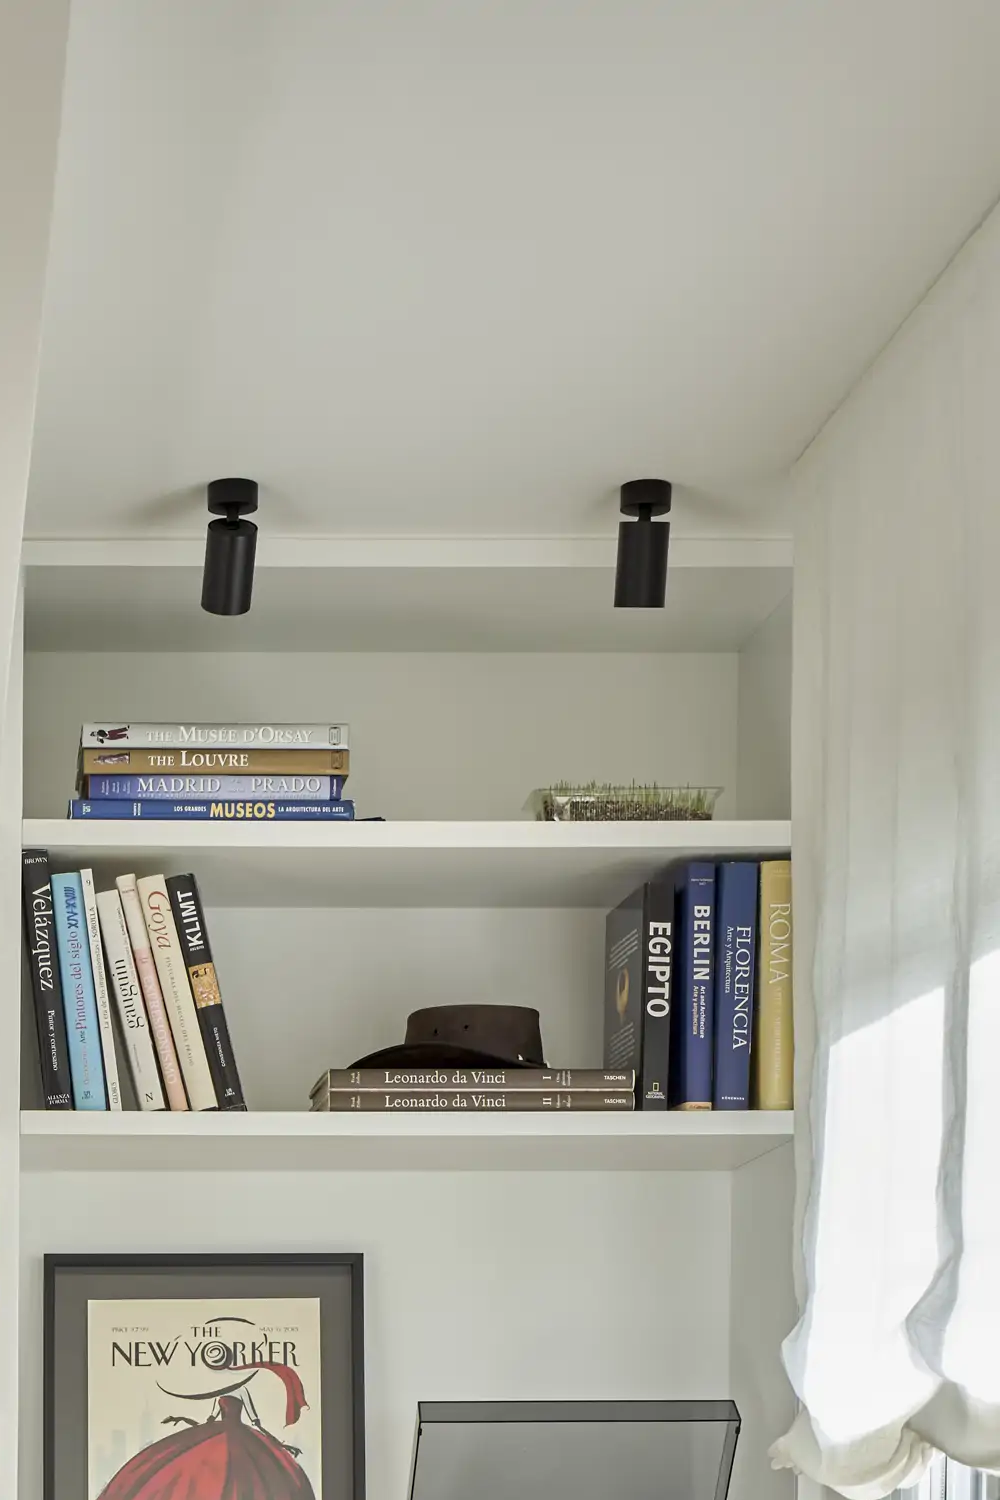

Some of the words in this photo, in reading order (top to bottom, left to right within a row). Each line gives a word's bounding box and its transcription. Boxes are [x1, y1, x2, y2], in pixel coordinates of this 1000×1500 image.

[179, 726, 238, 743] MUSÉE
[244, 725, 313, 744] D'ORSAY
[148, 755, 175, 767] THE
[180, 750, 250, 768] LOUVRE
[137, 777, 221, 793] MADRID
[251, 776, 322, 793] PRADO
[209, 802, 276, 819] MUSEOS
[286, 806, 322, 814] ARQUITECTURA
[24, 857, 48, 865] BROWN
[147, 890, 172, 950] Goya
[177, 890, 204, 950] KLIMT
[31, 884, 54, 992] Velázquez
[68, 930, 81, 956] siglo
[693, 904, 711, 981] BERLIN
[725, 925, 734, 942] Arte
[768, 902, 791, 985] ROMA
[69, 958, 81, 980] del
[646, 921, 672, 1018] EGIPTO
[724, 951, 733, 994] Arquitectura
[114, 959, 145, 1029] gauguin
[732, 925, 752, 1051] FLORENCIA
[75, 983, 88, 1031] Pintores
[50, 1038, 58, 1072] cortesano
[384, 1070, 448, 1085] Leonardo
[452, 1070, 468, 1084] da
[472, 1070, 506, 1084] Vinci
[46, 1093, 71, 1102] ALIANZA
[384, 1094, 448, 1111] Leonardo
[452, 1095, 468, 1108] da
[472, 1094, 506, 1108] Vinci
[190, 1326, 222, 1337] THE
[112, 1340, 177, 1367] NEW
